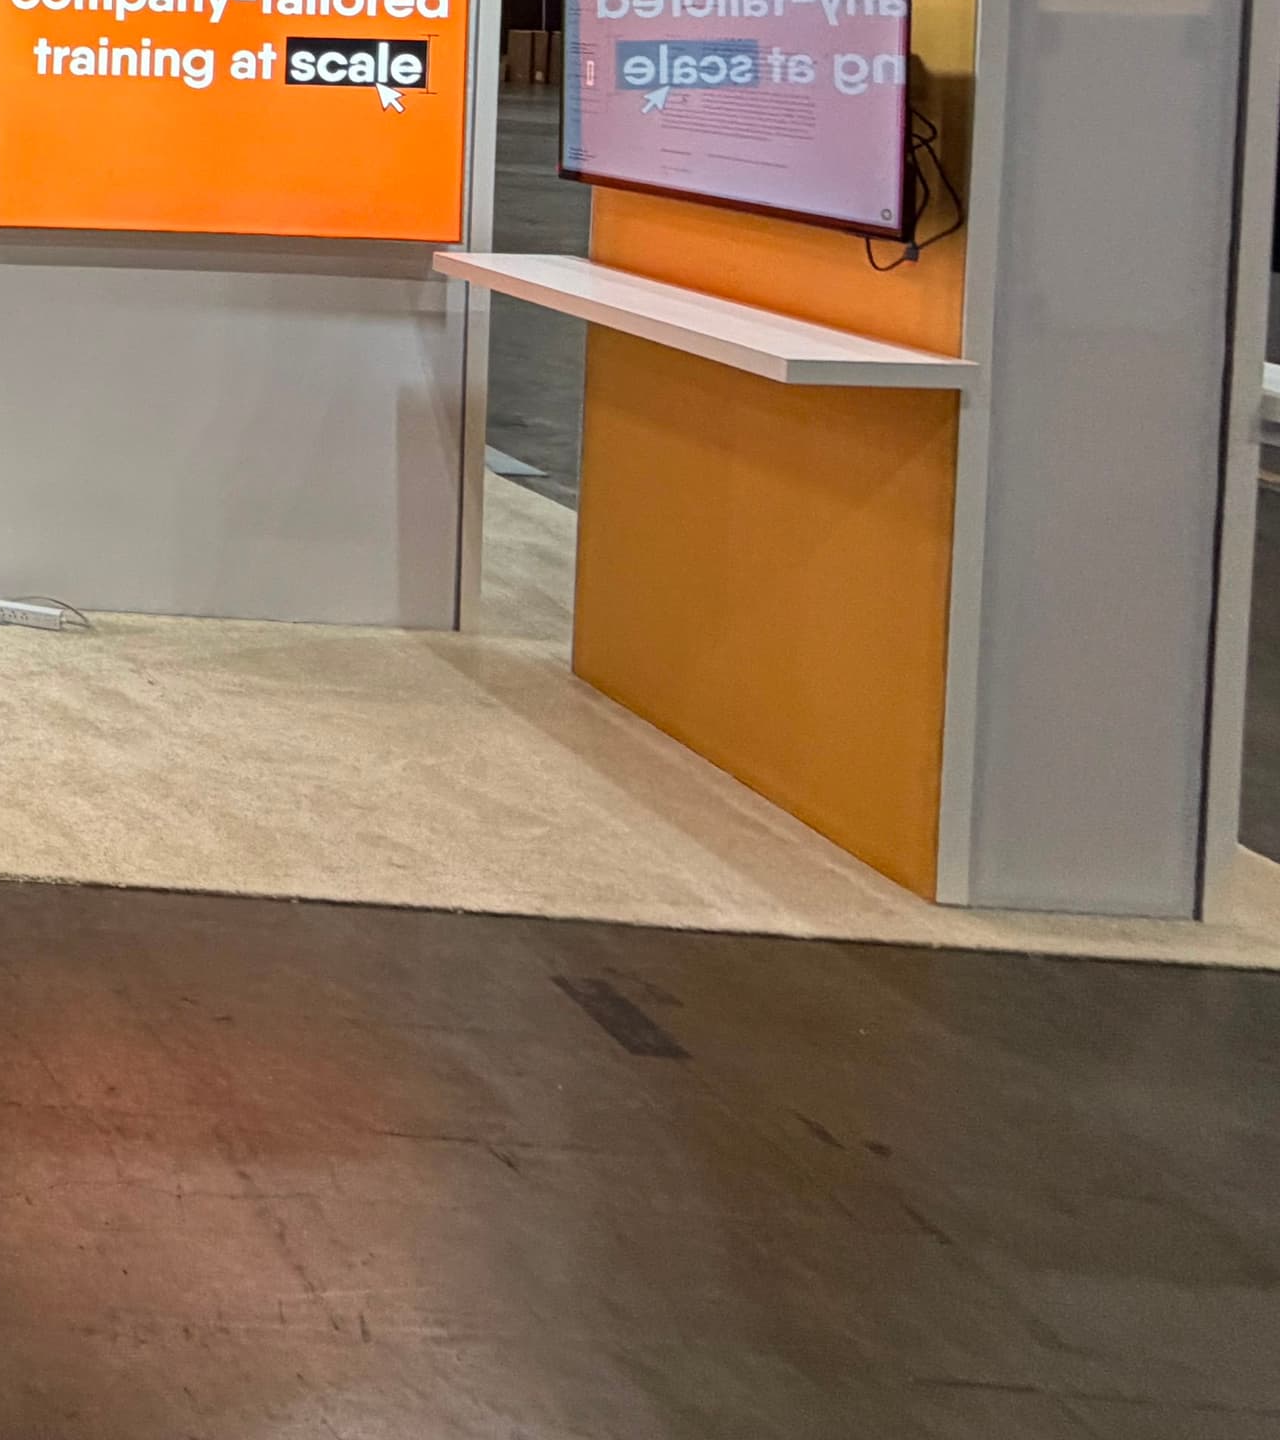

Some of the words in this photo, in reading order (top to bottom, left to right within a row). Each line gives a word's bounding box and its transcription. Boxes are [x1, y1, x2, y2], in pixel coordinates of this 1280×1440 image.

[33, 37, 214, 89] training
[230, 41, 277, 80] at
[290, 42, 423, 85] scale
